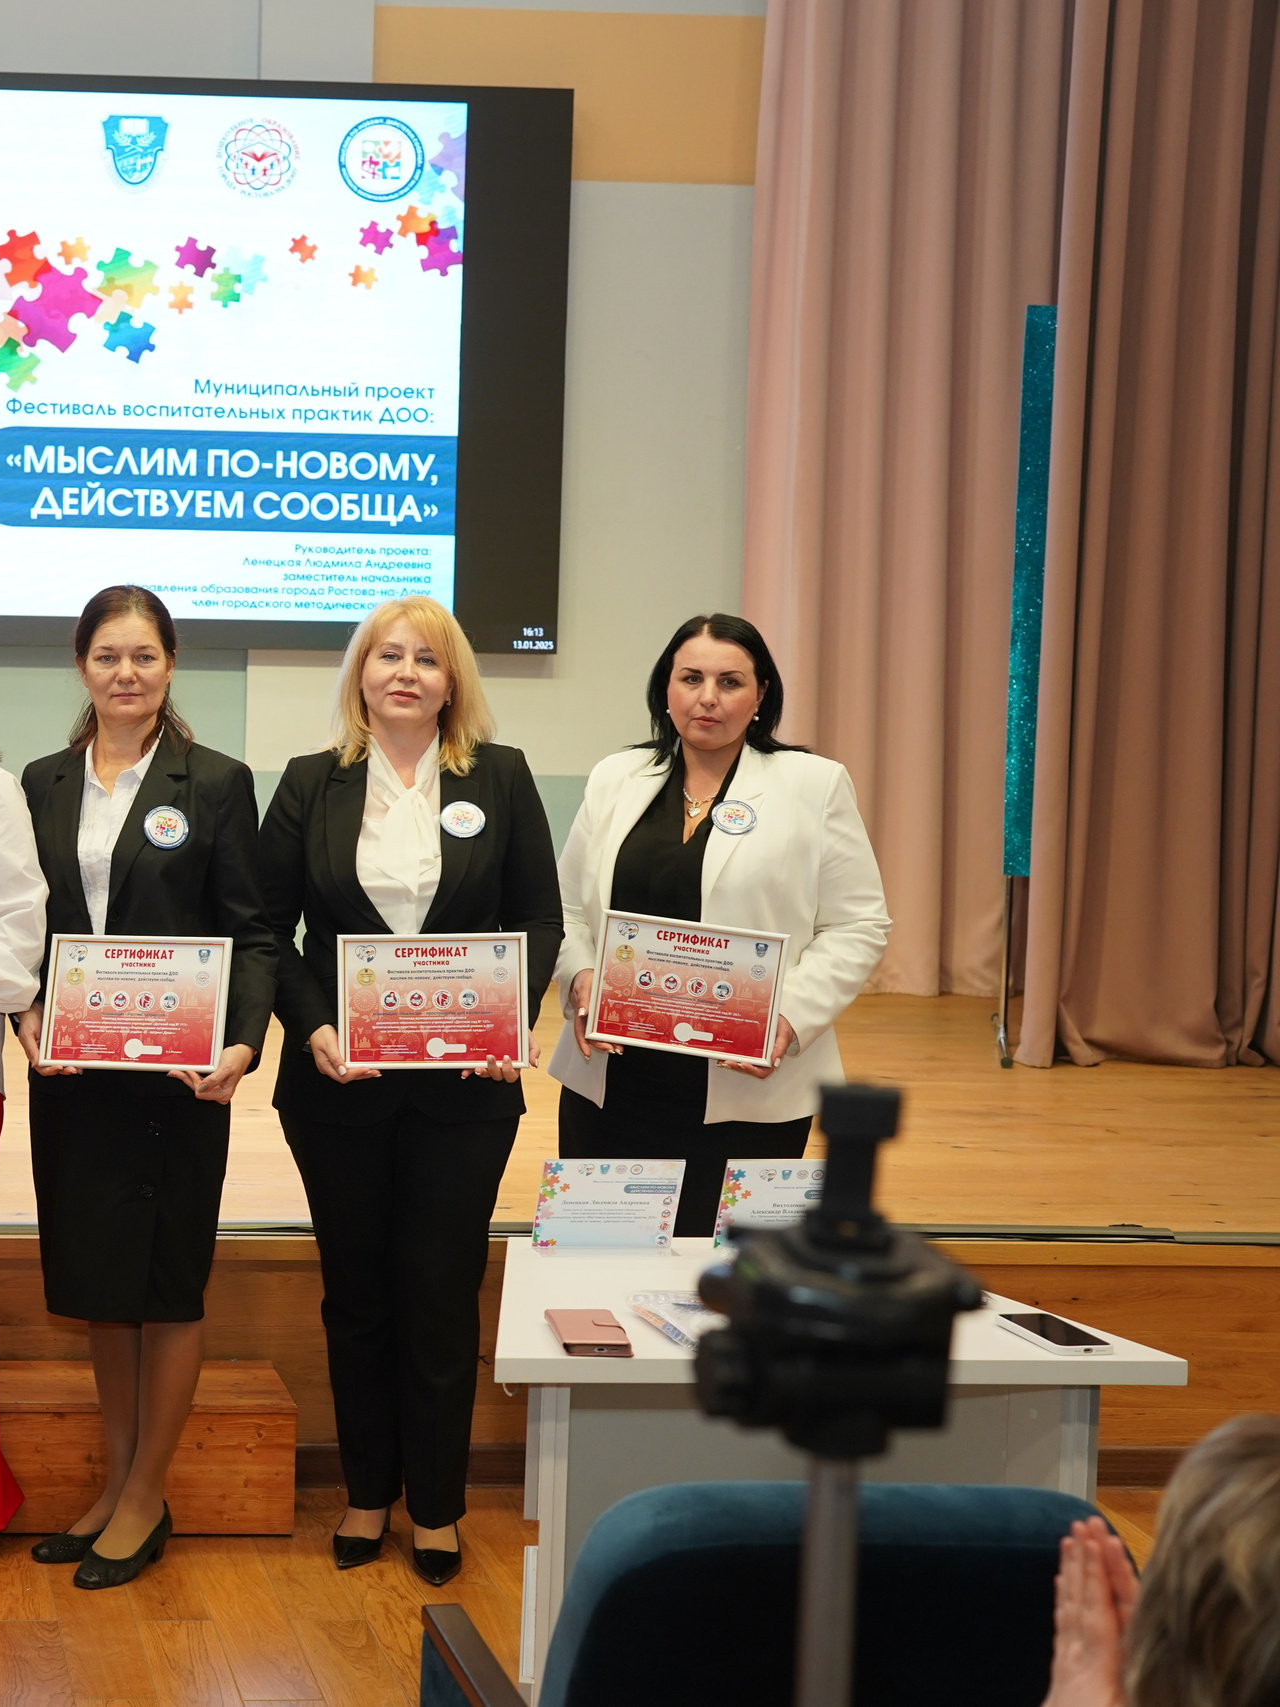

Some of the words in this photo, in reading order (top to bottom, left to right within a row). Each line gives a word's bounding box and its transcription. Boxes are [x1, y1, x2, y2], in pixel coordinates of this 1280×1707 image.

[194, 379, 359, 398] Муниципальный
[365, 386, 435, 401] проект
[6, 397, 117, 415] Фестиваль
[123, 404, 286, 420] воспитательных
[292, 408, 373, 423] практик
[379, 407, 434, 424] ДОО:
[6, 445, 197, 477] «МЫСЛИМ
[207, 448, 439, 486] ПО-НОВОМУ,
[30, 481, 244, 519] ДЕЙСТВУЕМ
[253, 491, 439, 526] СООБЩА»
[295, 544, 376, 555] Руководитель
[380, 547, 432, 558] проекта:
[242, 557, 301, 568] Ленецкая
[304, 558, 362, 569] Людмила
[365, 560, 431, 570] Андреевна
[283, 573, 358, 582] заместитель
[361, 574, 431, 584] начальника
[200, 583, 279, 595] образования
[282, 586, 325, 597] города
[221, 600, 291, 609] городского
[523, 627, 544, 637] 16:13
[513, 640, 554, 650] 13.01.2025
[656, 930, 730, 949] СЕРТИФИКАТ
[104, 948, 174, 960] СЕРТИФИКАТ
[394, 946, 468, 958] СЕРТИФИКАТ
[673, 945, 710, 955] участника
